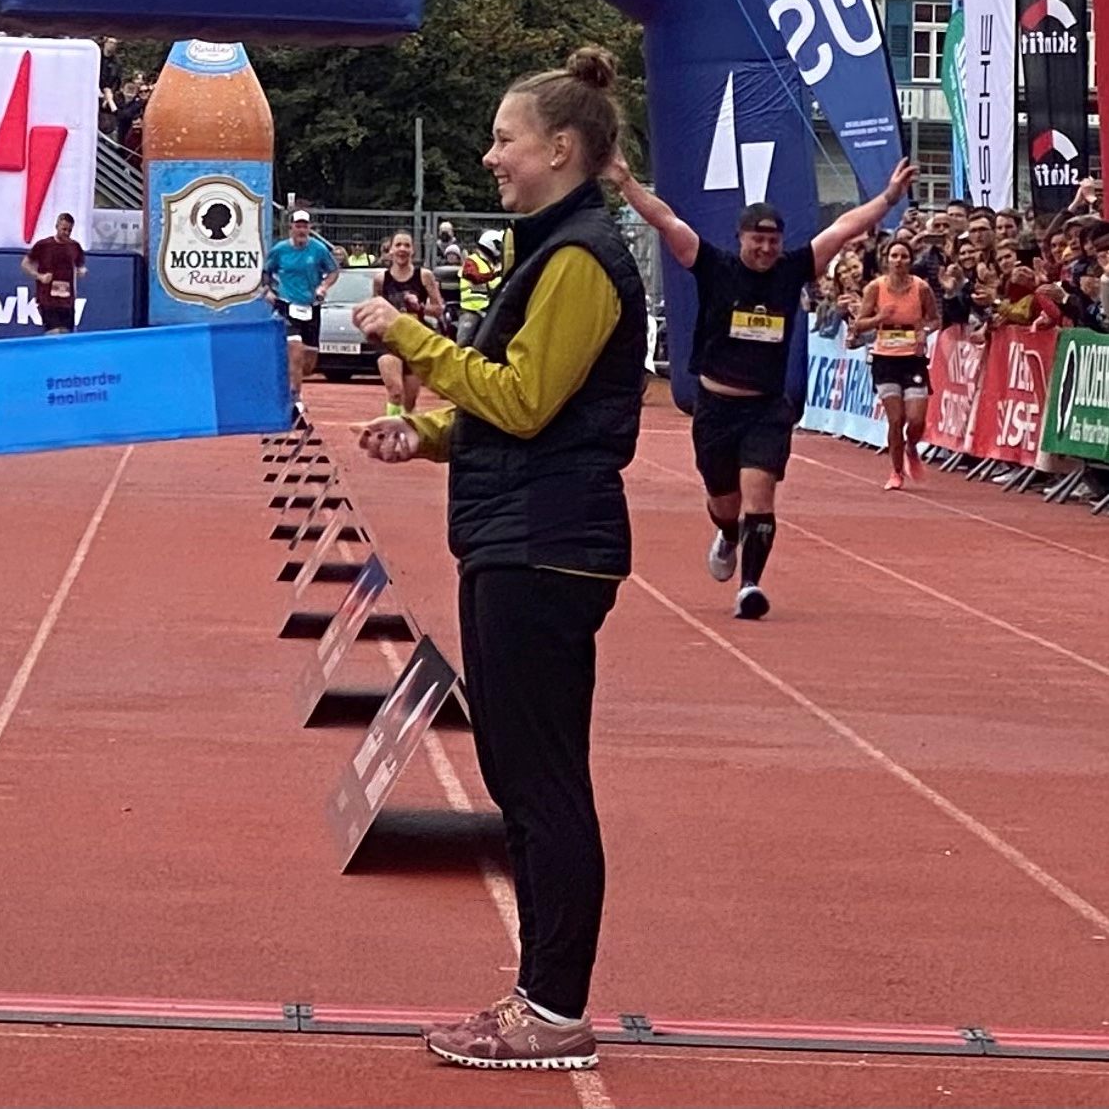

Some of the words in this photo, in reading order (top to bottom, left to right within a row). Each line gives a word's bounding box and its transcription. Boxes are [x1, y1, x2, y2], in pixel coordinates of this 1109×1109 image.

[170, 250, 260, 270] MOHREN
[187, 269, 246, 286] Radler
[45, 372, 122, 391] #noborder
[46, 390, 109, 407] #nolimit
